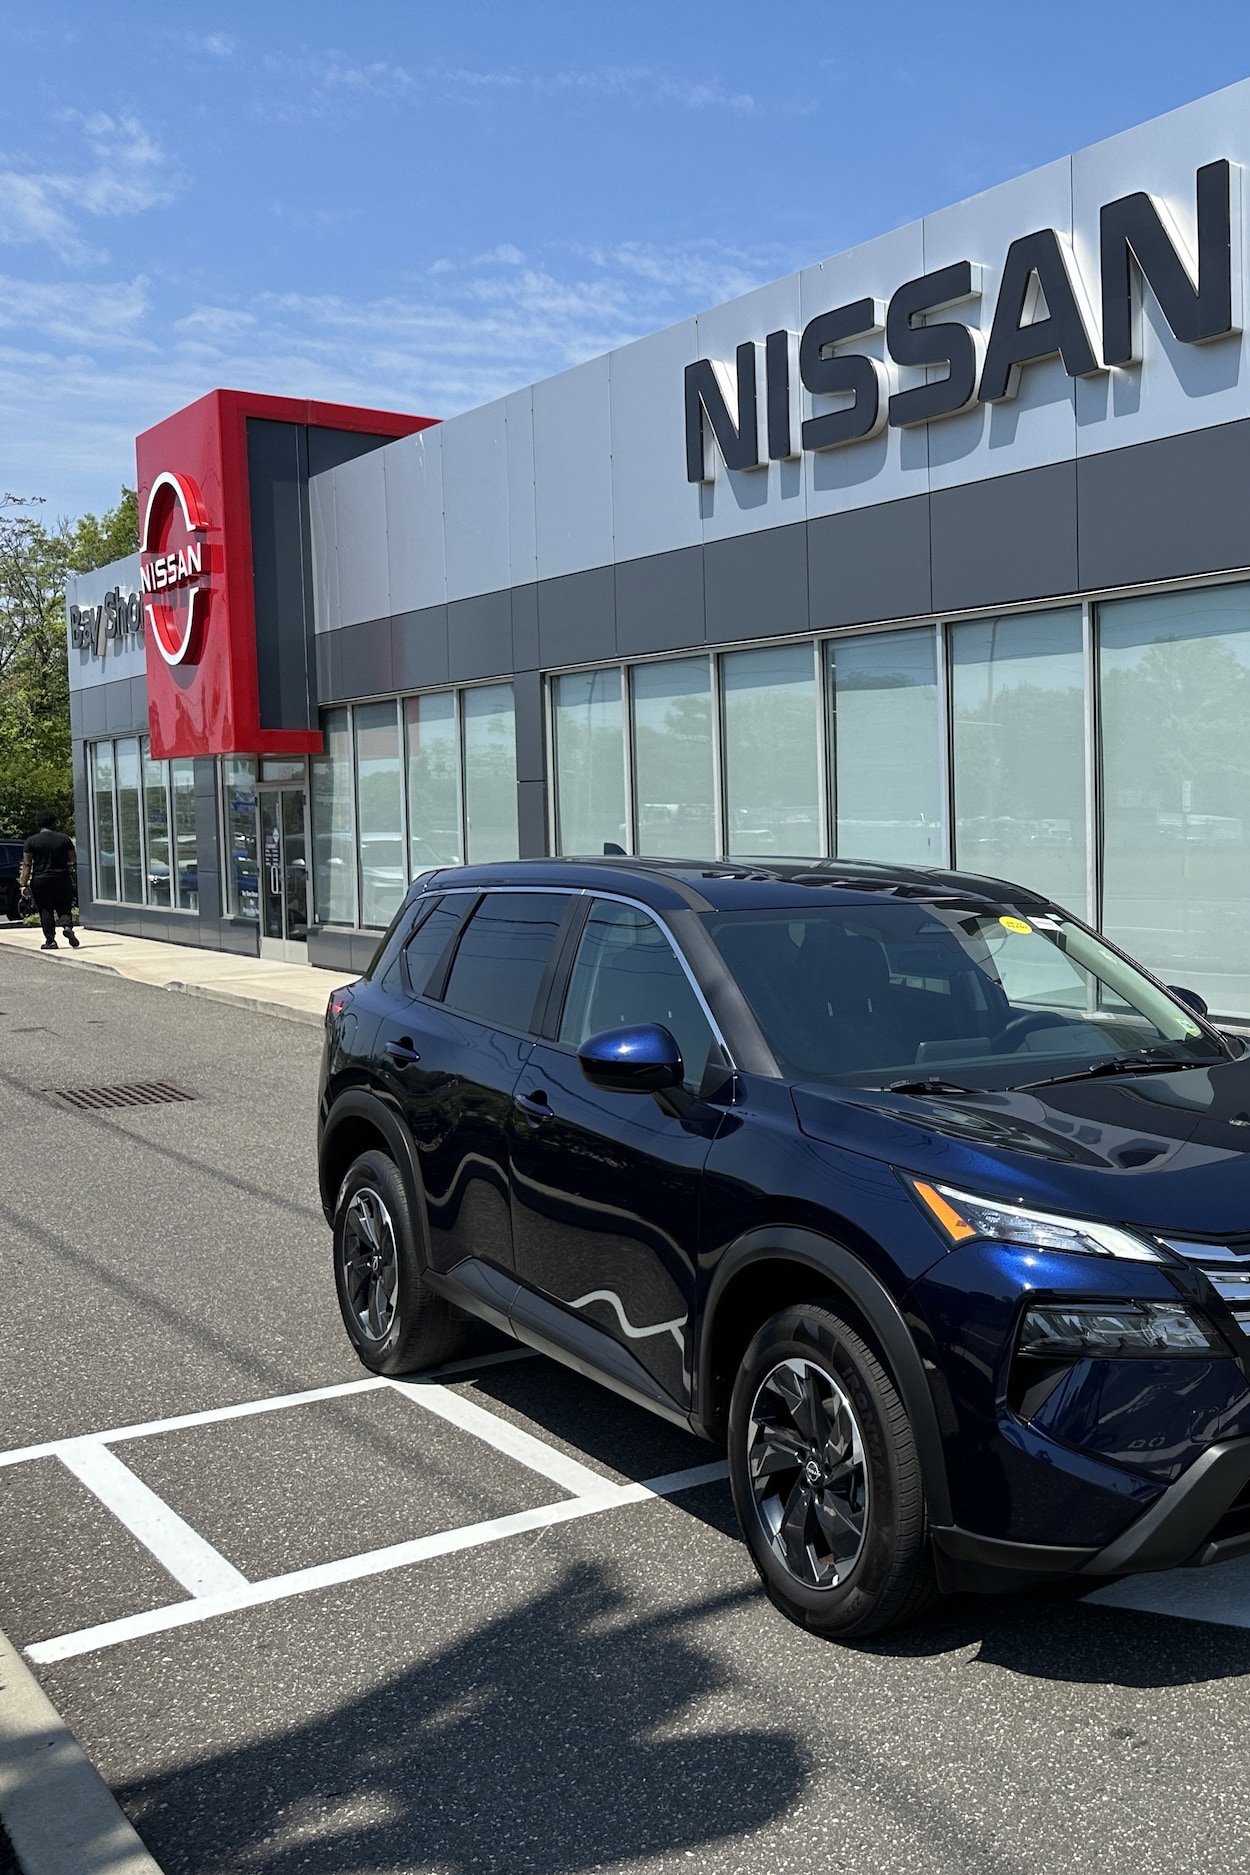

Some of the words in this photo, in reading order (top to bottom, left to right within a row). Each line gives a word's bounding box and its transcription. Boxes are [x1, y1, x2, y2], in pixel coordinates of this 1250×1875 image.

[684, 159, 1238, 483] NISSAN
[140, 542, 202, 594] NISSAN
[70, 605, 105, 656] Bay
